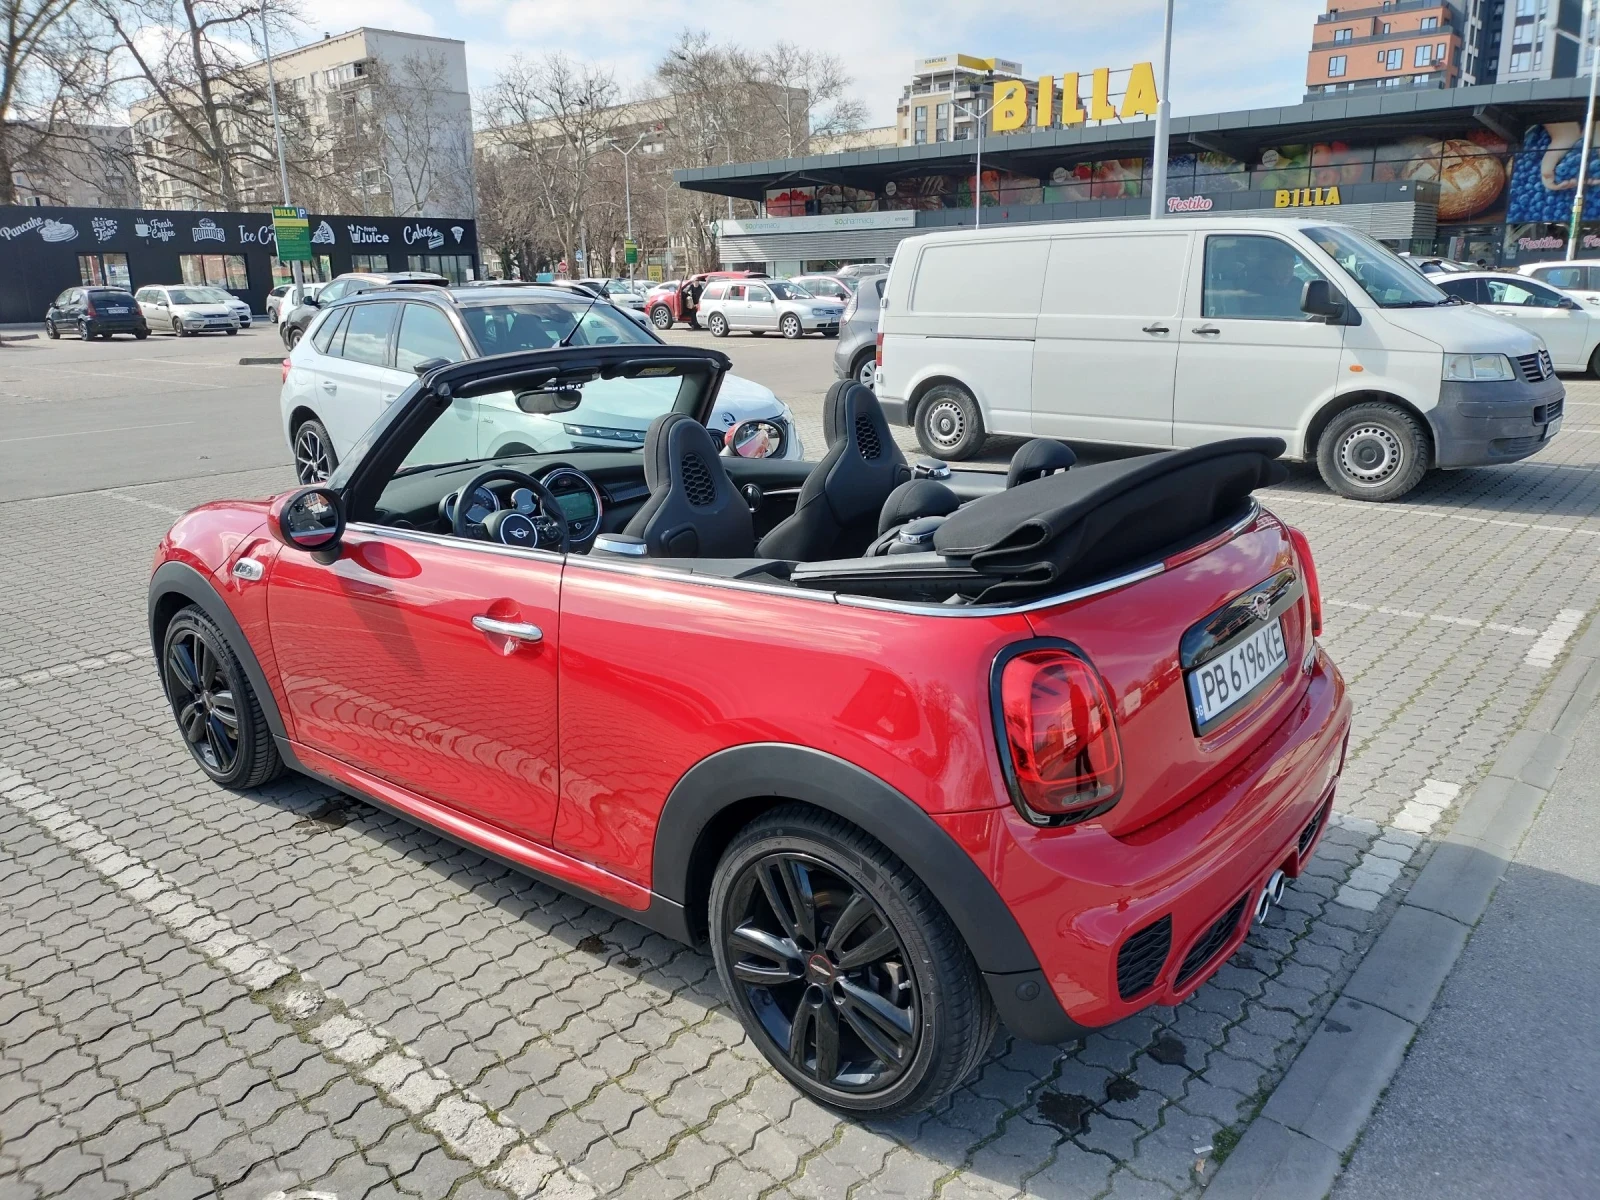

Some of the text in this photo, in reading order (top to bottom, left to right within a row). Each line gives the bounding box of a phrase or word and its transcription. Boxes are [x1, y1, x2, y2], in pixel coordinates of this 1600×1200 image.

[993, 62, 1160, 132] BILLA
[1167, 195, 1213, 212] Festiko
[1274, 186, 1341, 208] BILLA
[0, 217, 44, 241] Pancake
[150, 218, 174, 230] Fresh
[238, 224, 256, 244] Ice
[403, 223, 433, 245] Cakes
[151, 228, 176, 242] Coffee
[192, 227, 226, 243] POTATOES
[360, 232, 390, 243] Juice
[1201, 664, 1229, 712] PB
[1230, 636, 1266, 692] 6196
[1264, 623, 1284, 666] KE
